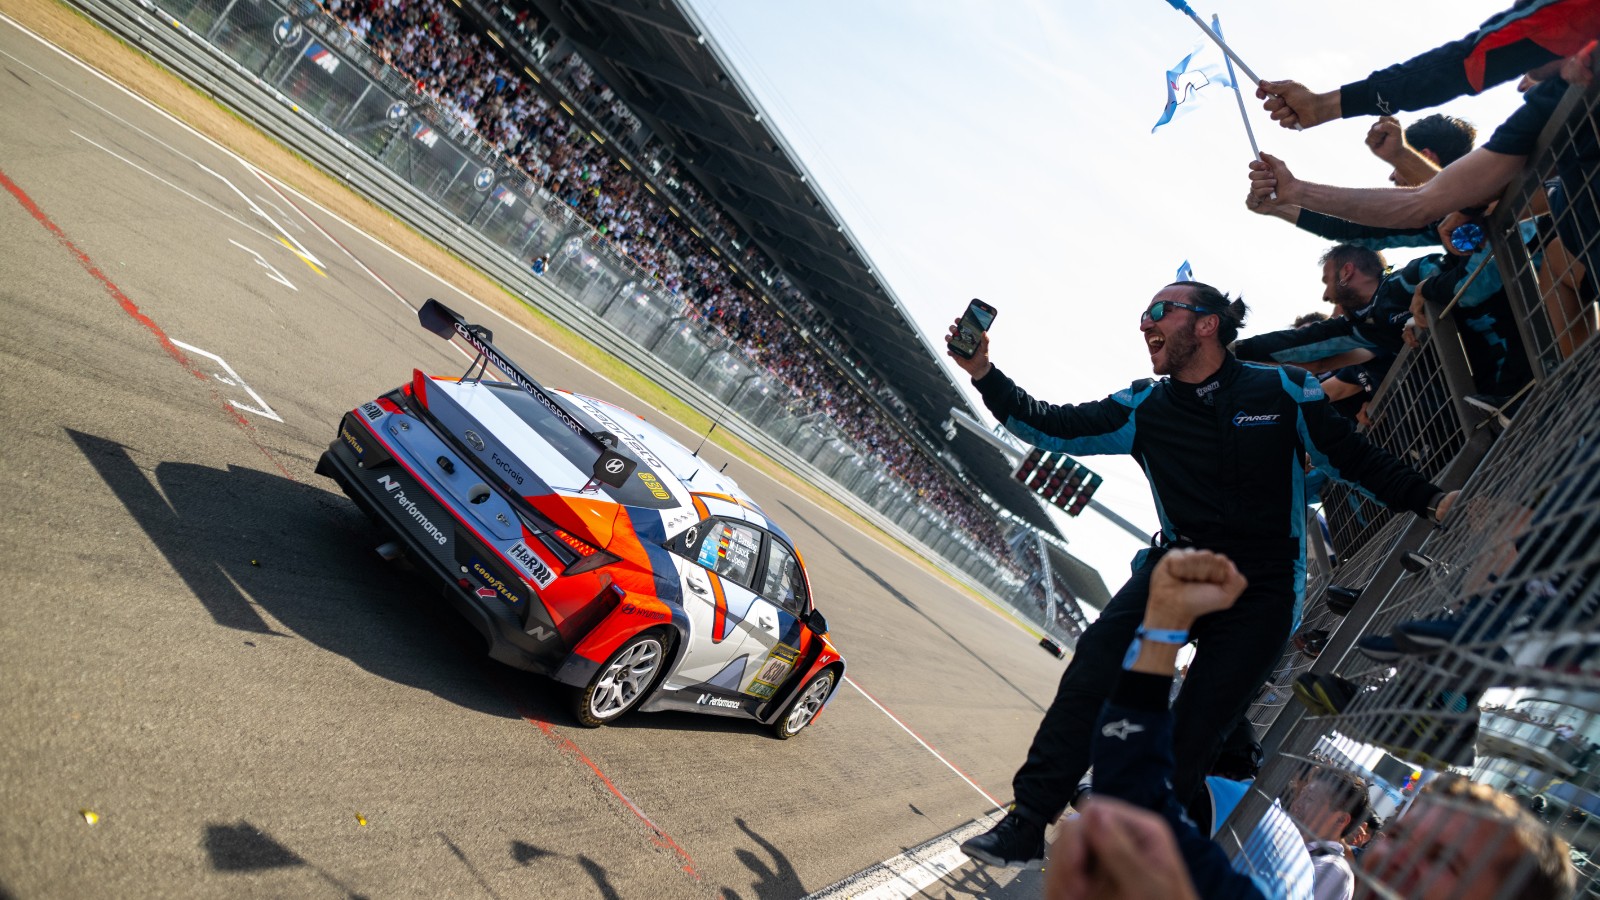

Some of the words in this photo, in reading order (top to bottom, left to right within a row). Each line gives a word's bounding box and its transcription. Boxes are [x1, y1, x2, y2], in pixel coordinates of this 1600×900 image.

[472, 338, 517, 381] HYUNDAI
[517, 377, 583, 436] MOTORSPORT
[1236, 414, 1281, 424] TARGET
[637, 471, 671, 500] 830
[394, 489, 448, 546] Performance
[473, 562, 519, 604] GOODYEAR
[636, 608, 666, 620] HYUNDAI
[762, 662, 786, 682] 830
[709, 696, 740, 709] Performance
